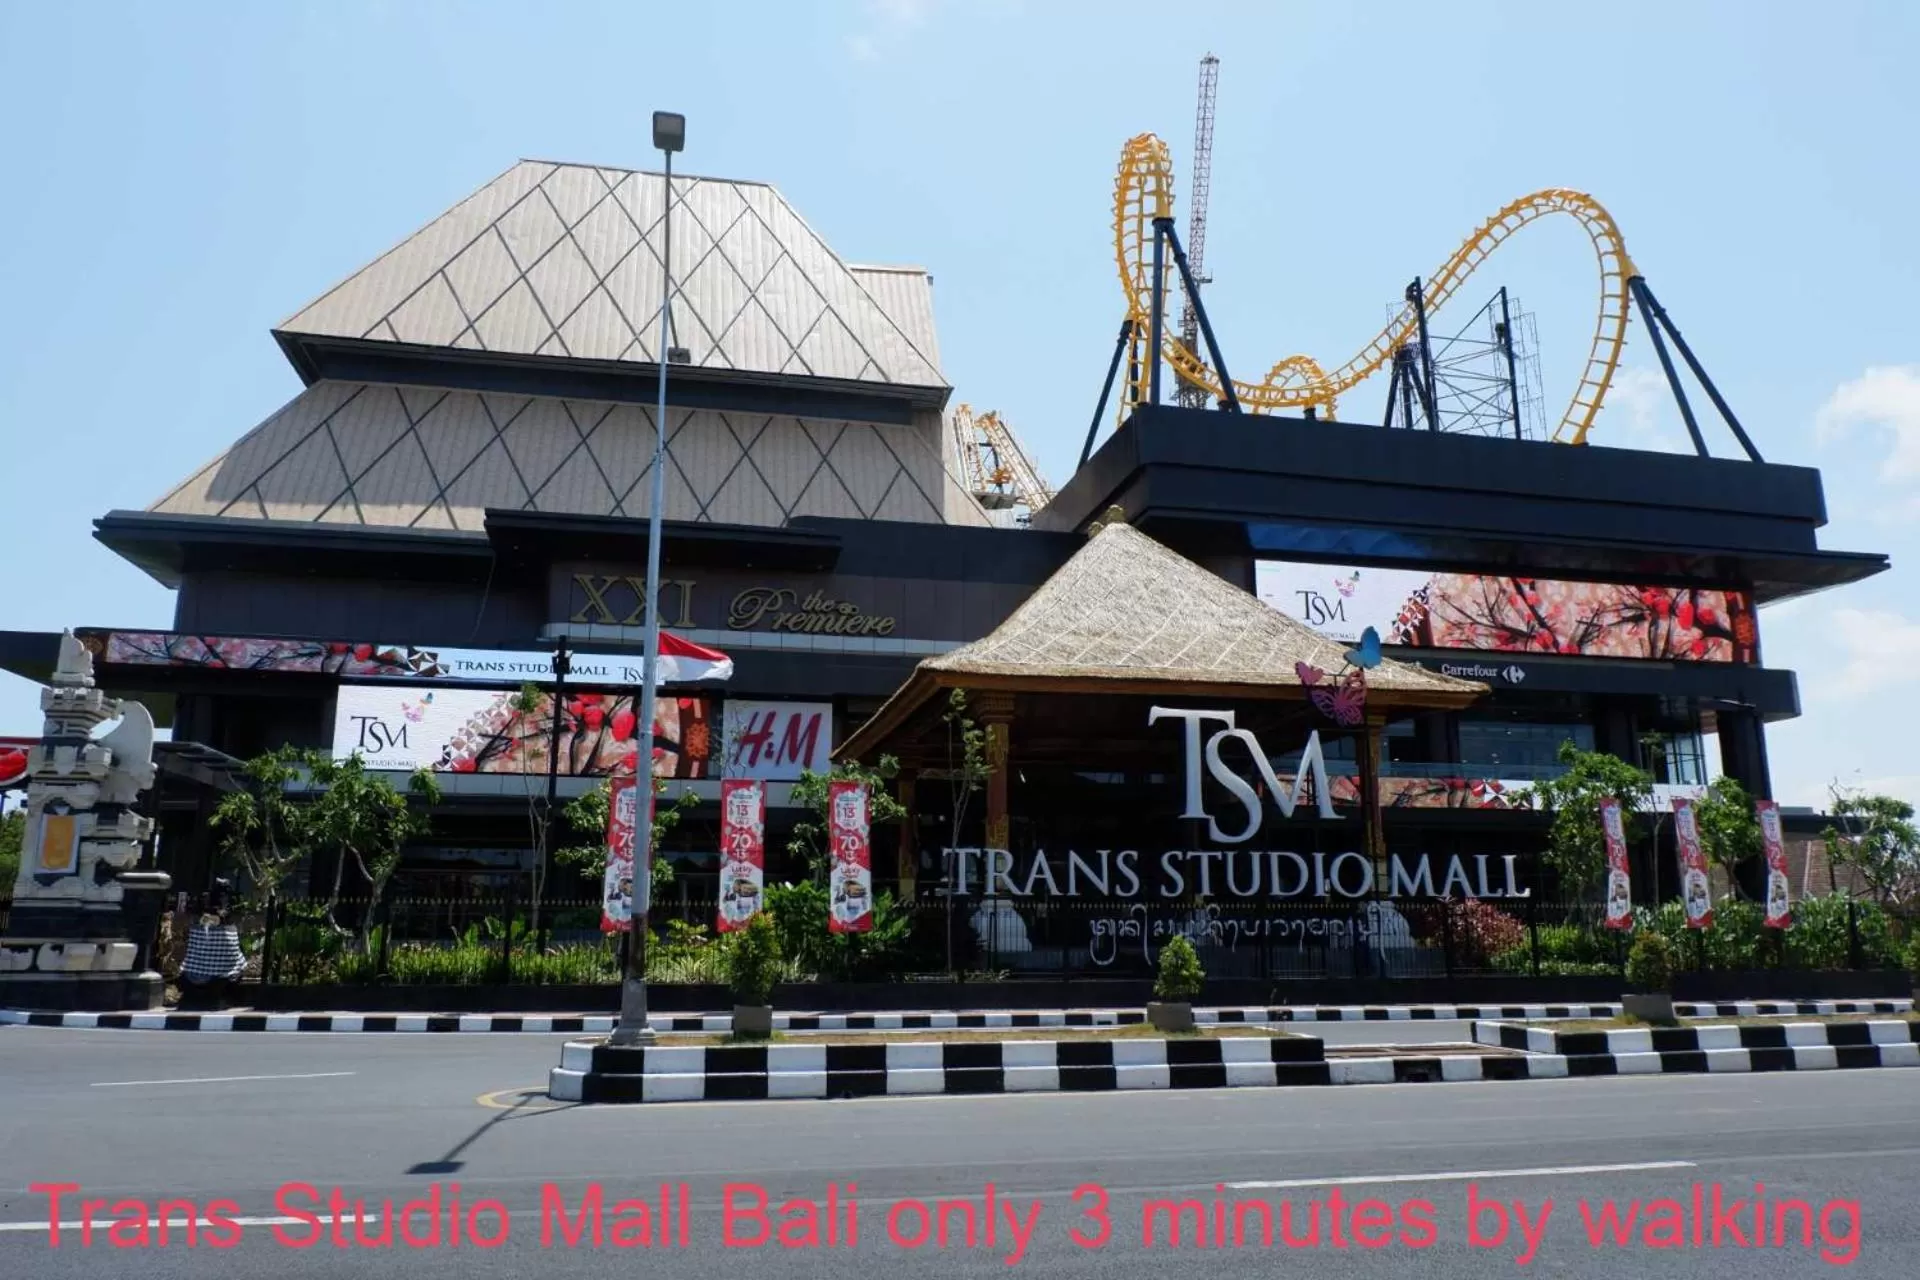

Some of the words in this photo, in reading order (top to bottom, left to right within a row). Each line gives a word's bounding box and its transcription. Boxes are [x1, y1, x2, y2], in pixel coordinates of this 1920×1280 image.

[571, 573, 697, 628] XXI
[727, 586, 897, 636] Premiere
[803, 590, 835, 613] the
[1296, 590, 1346, 626] TSM
[455, 660, 505, 671] TRANS
[570, 666, 609, 676] MALL
[1441, 663, 1498, 677] Carrefour
[350, 715, 411, 754] TSM
[733, 710, 823, 768] H&M
[1148, 705, 1346, 843] TSM
[942, 848, 1140, 897] TRANS
[1160, 850, 1373, 898] STUDIO
[1389, 852, 1531, 898] MALL
